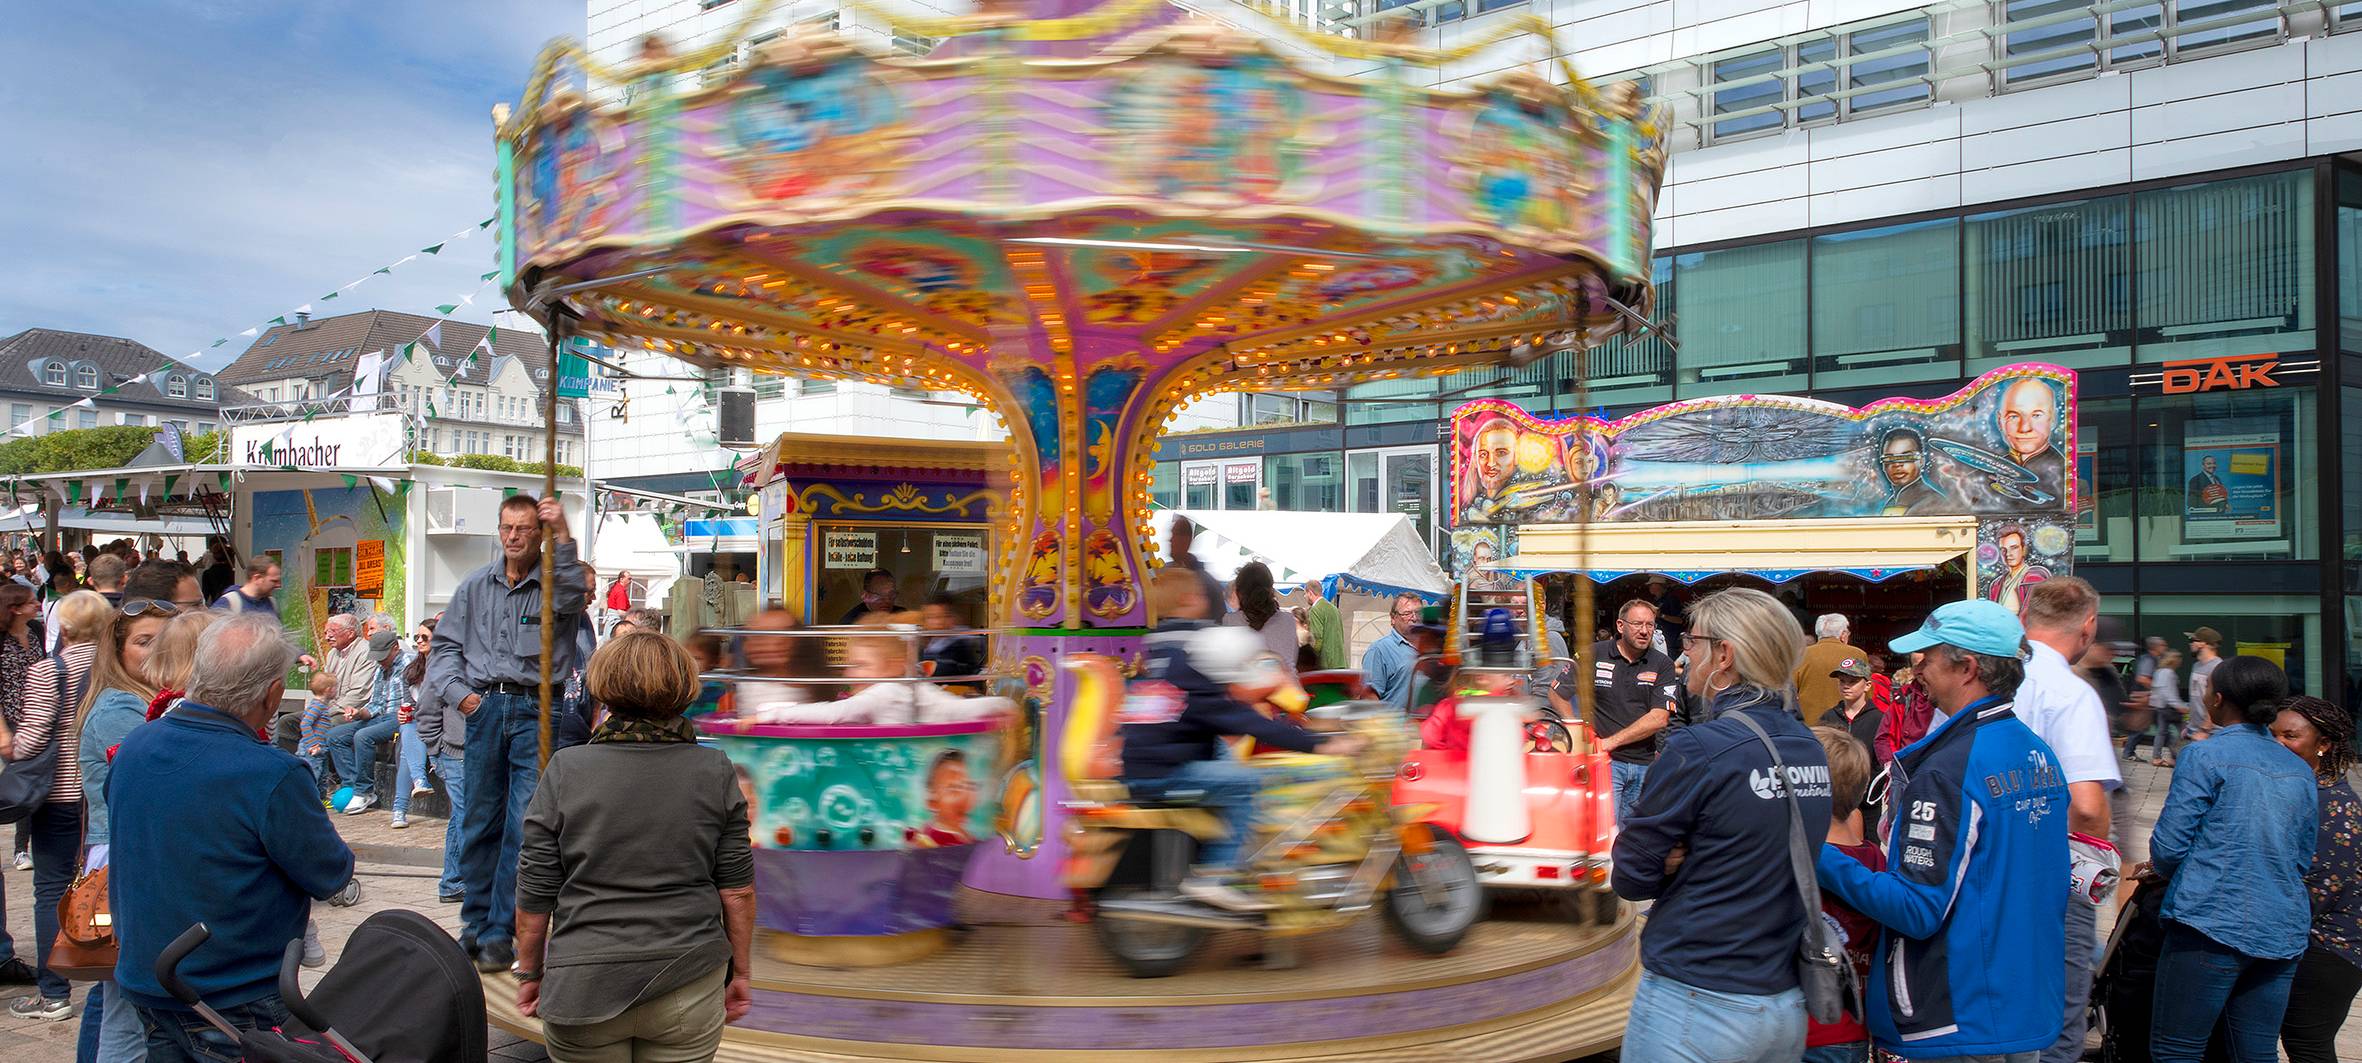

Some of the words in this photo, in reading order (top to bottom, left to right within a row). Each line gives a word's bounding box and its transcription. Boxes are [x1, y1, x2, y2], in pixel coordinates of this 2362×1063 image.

[2163, 353, 2281, 394] DAK
[559, 375, 618, 392] KOMPANIE
[247, 435, 341, 467] Krmbacher
[1228, 465, 1256, 475] Altgold
[1910, 800, 1937, 821] 25
[1906, 845, 1933, 857] ROUGH
[1904, 853, 1935, 867] WATERS
